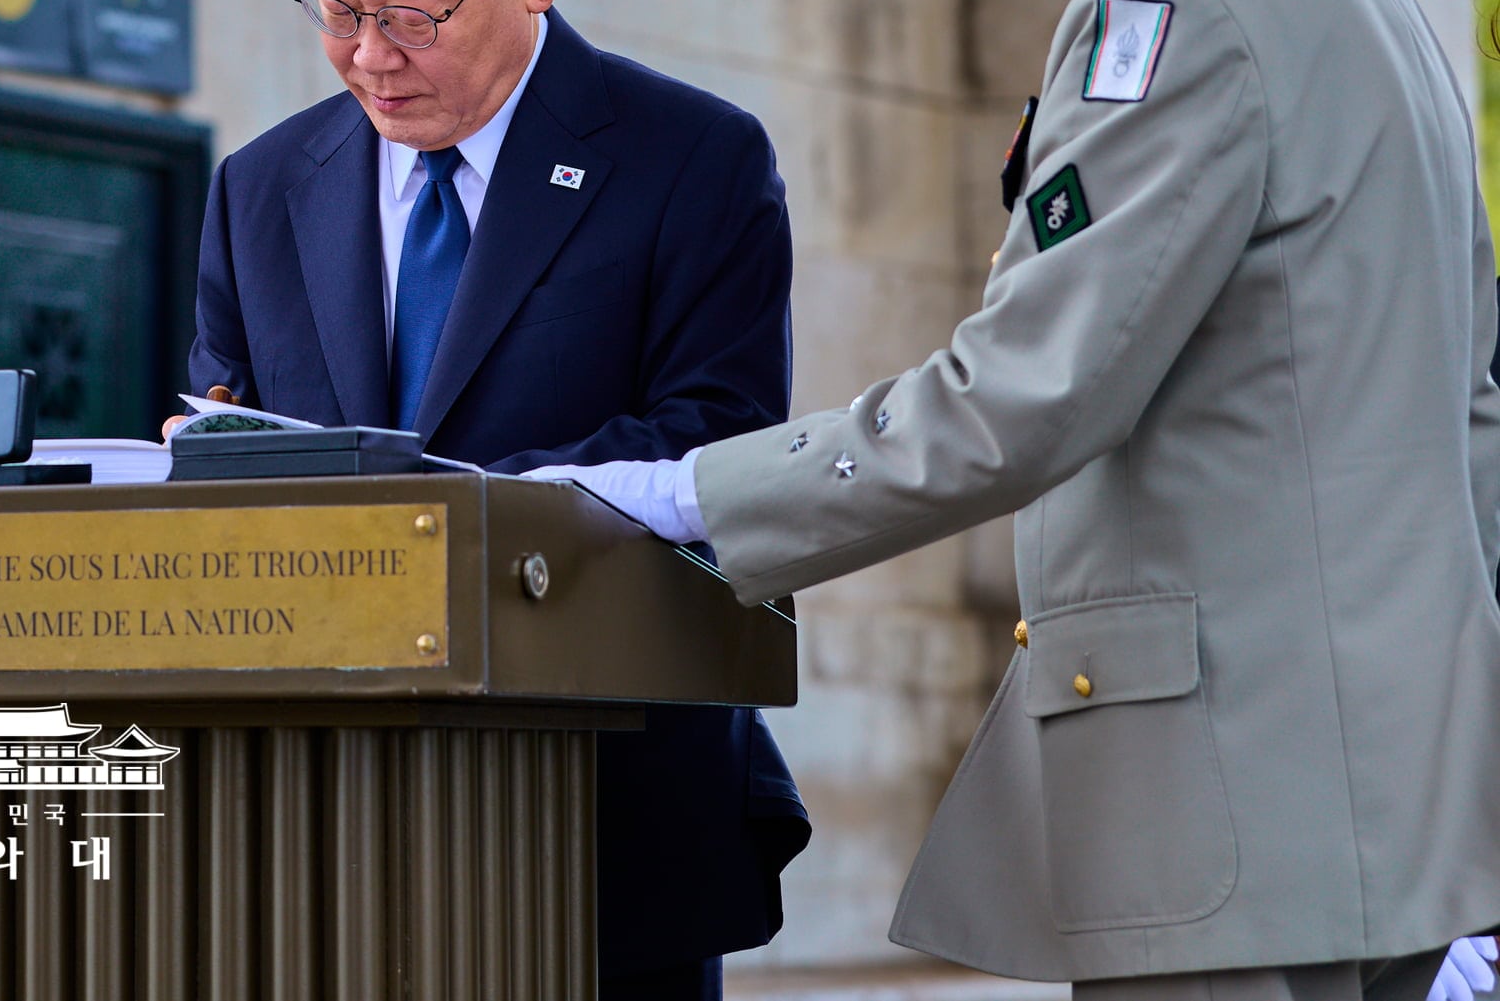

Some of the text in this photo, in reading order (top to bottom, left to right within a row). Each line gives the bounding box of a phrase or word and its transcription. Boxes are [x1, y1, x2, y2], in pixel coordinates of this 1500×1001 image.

[29, 553, 104, 583] SOUS
[113, 551, 192, 580] L'ARC
[201, 550, 240, 579] DE
[247, 548, 408, 579] TRIOMPHE
[93, 609, 131, 638] DE
[140, 609, 177, 637] LA
[184, 606, 296, 636] NATION
